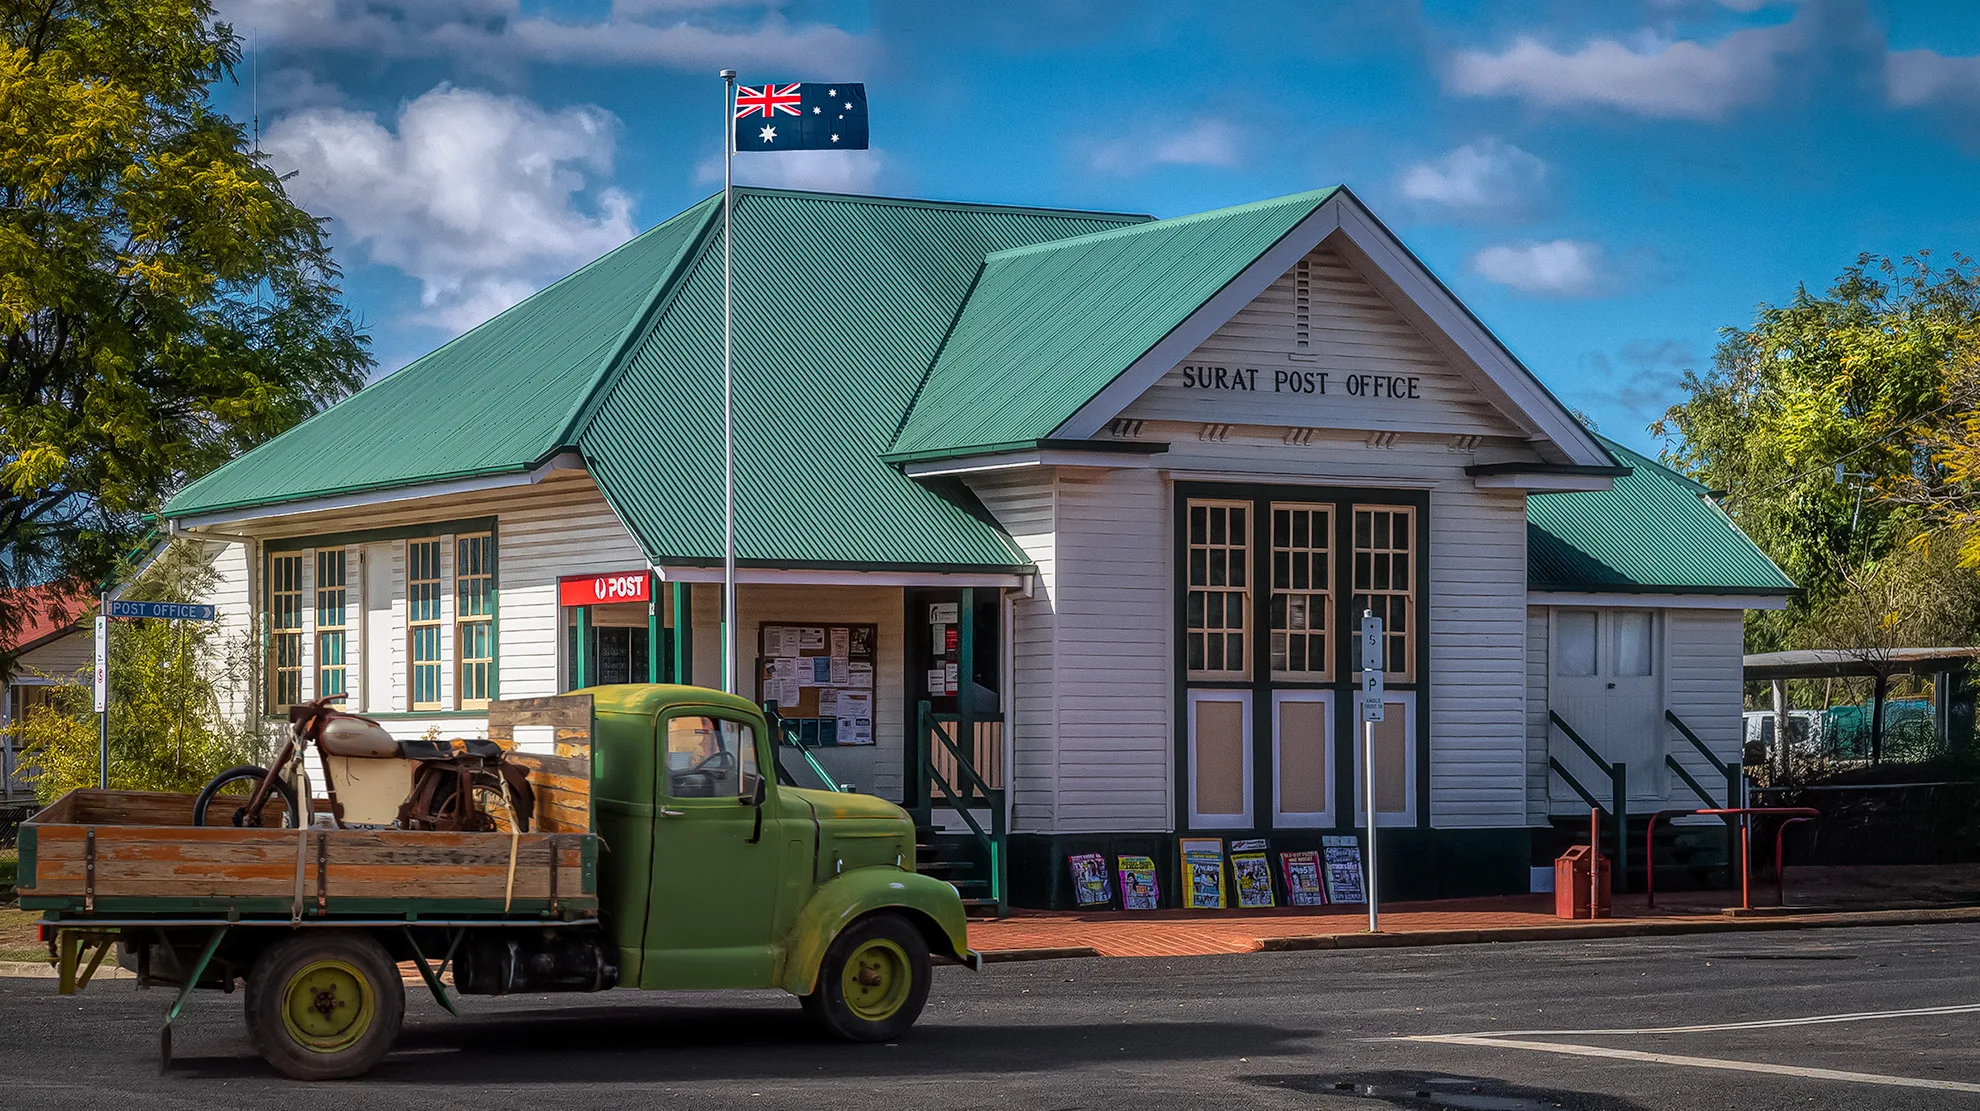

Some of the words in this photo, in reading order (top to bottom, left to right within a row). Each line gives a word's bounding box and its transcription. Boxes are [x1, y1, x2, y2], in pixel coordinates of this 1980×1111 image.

[1183, 366, 1259, 391] SURAT
[1274, 370, 1329, 394] POST
[1346, 374, 1421, 399] OFFICE
[609, 577, 642, 597] POST
[113, 603, 145, 615] POST
[153, 604, 197, 618] OFFICE
[1369, 677, 1376, 691] P
